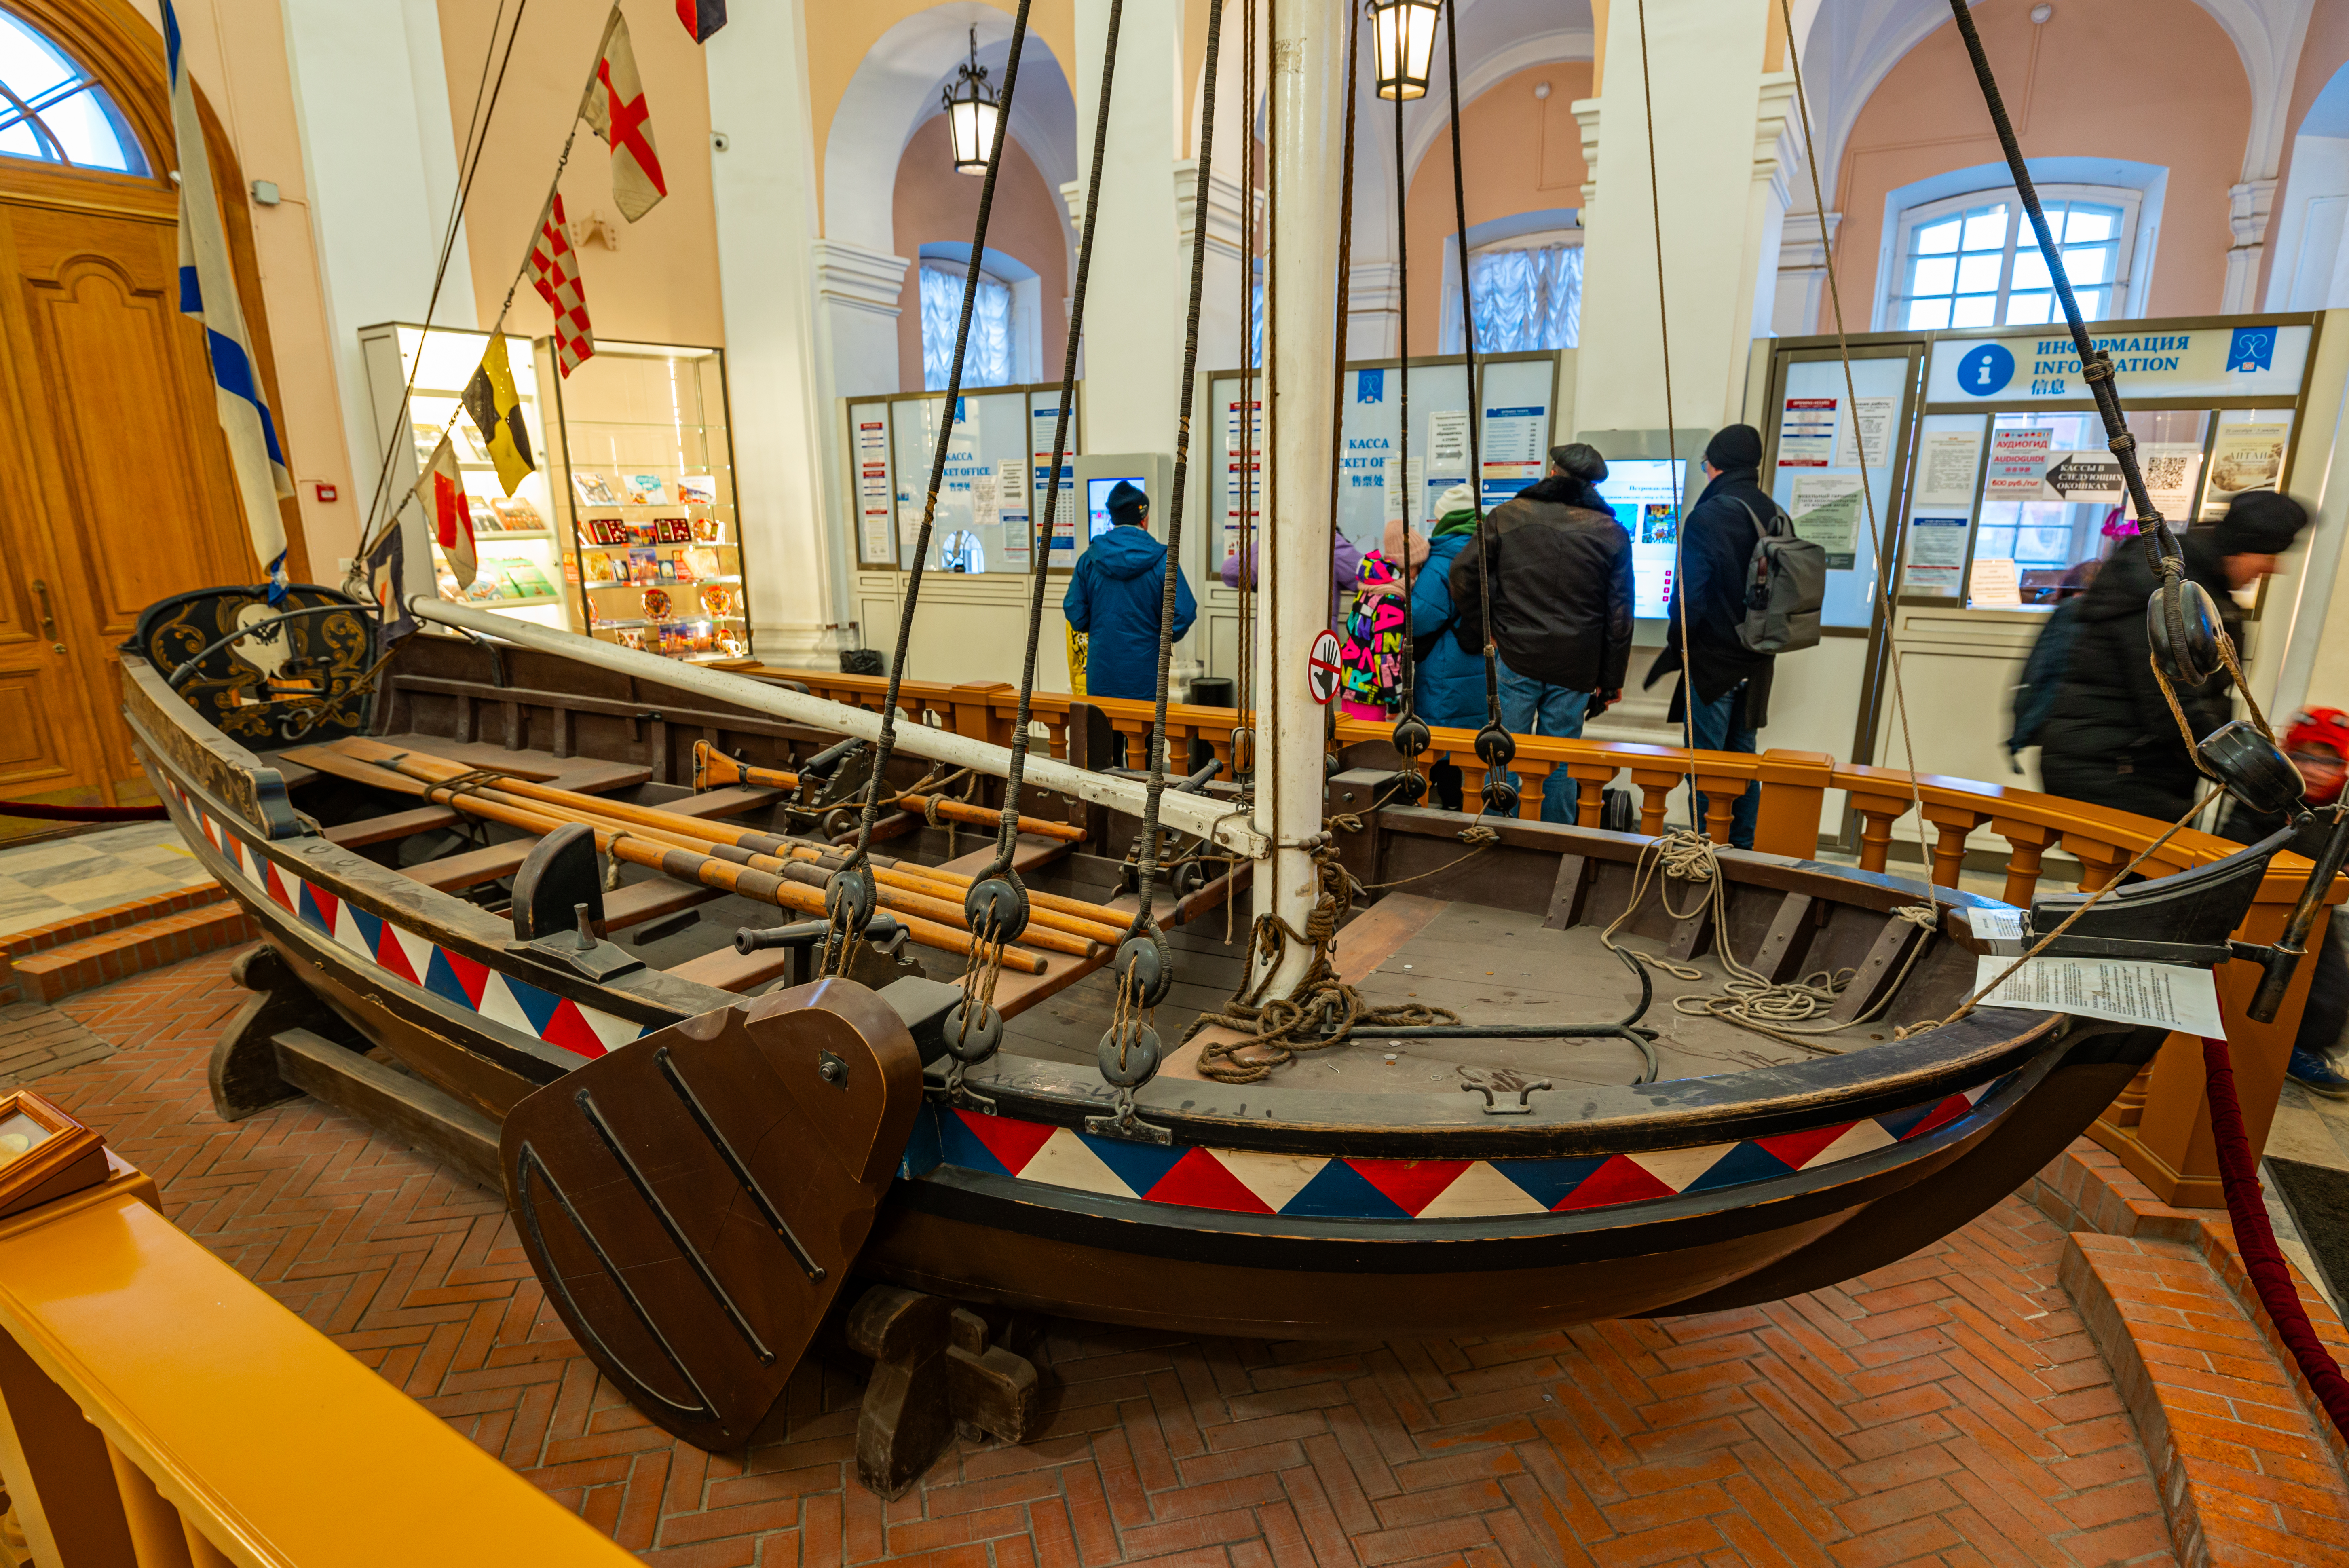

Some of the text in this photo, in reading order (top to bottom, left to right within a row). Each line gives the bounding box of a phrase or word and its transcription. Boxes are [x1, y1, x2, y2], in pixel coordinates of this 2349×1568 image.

[2034, 357, 2179, 374] INFOATION
[2031, 378, 2065, 395] 信息
[1349, 438, 1389, 449] КАССА
[1996, 440, 2048, 449] АУДИОГИД
[960, 467, 991, 476] OFFICE
[2058, 473, 2122, 482] СЛЕДУЮЩИХ
[2057, 482, 2108, 490] ОКОШКАХ
